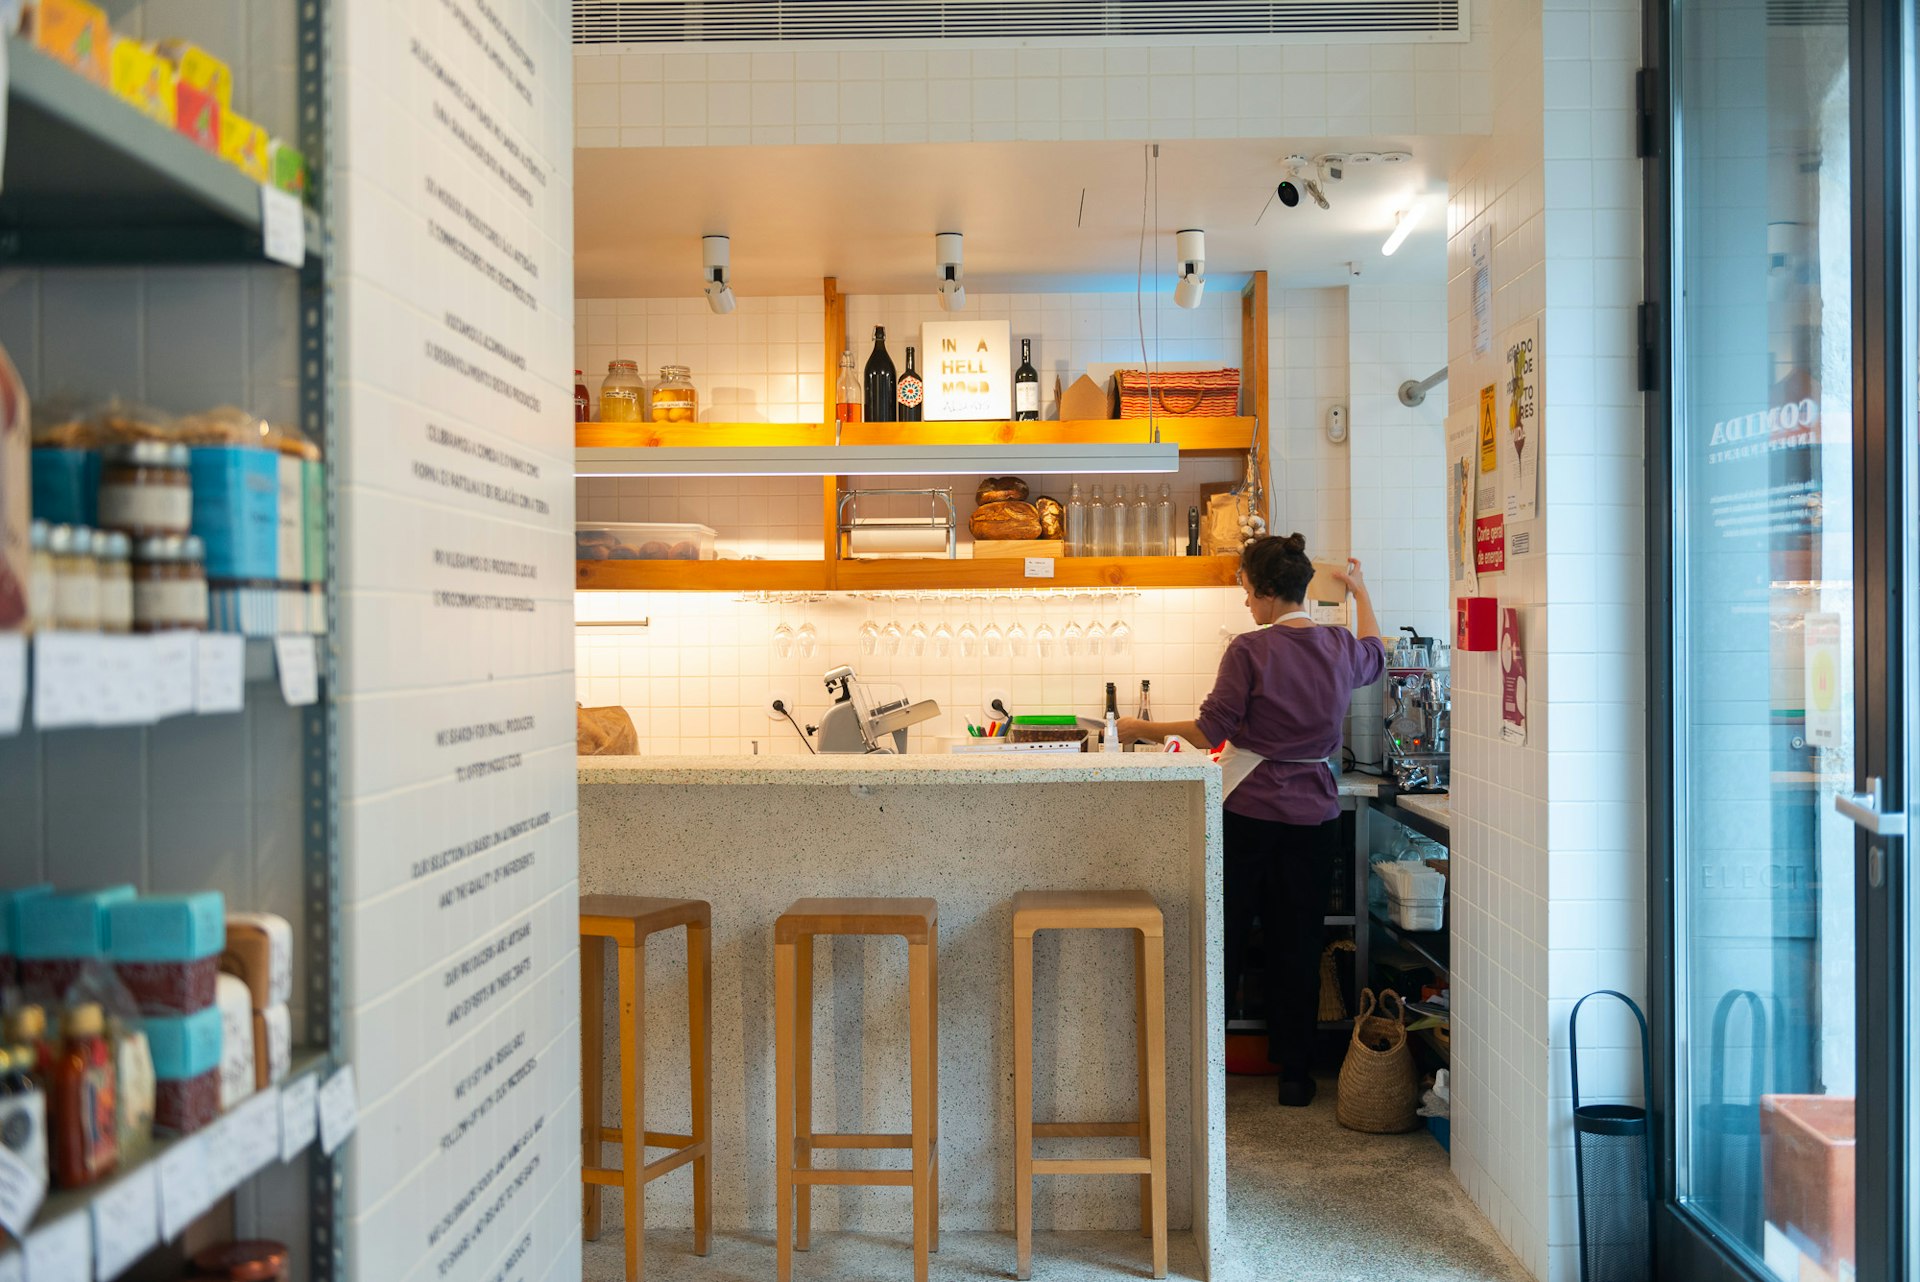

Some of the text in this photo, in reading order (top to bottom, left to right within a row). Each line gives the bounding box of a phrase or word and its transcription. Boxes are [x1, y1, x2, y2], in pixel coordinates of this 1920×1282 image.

[942, 338, 988, 352] IN A
[942, 360, 988, 374] HELL
[942, 381, 990, 394] MOOD
[1476, 526, 1490, 542] Corte
[1490, 523, 1503, 544] geral
[1477, 547, 1503, 568] de energia
